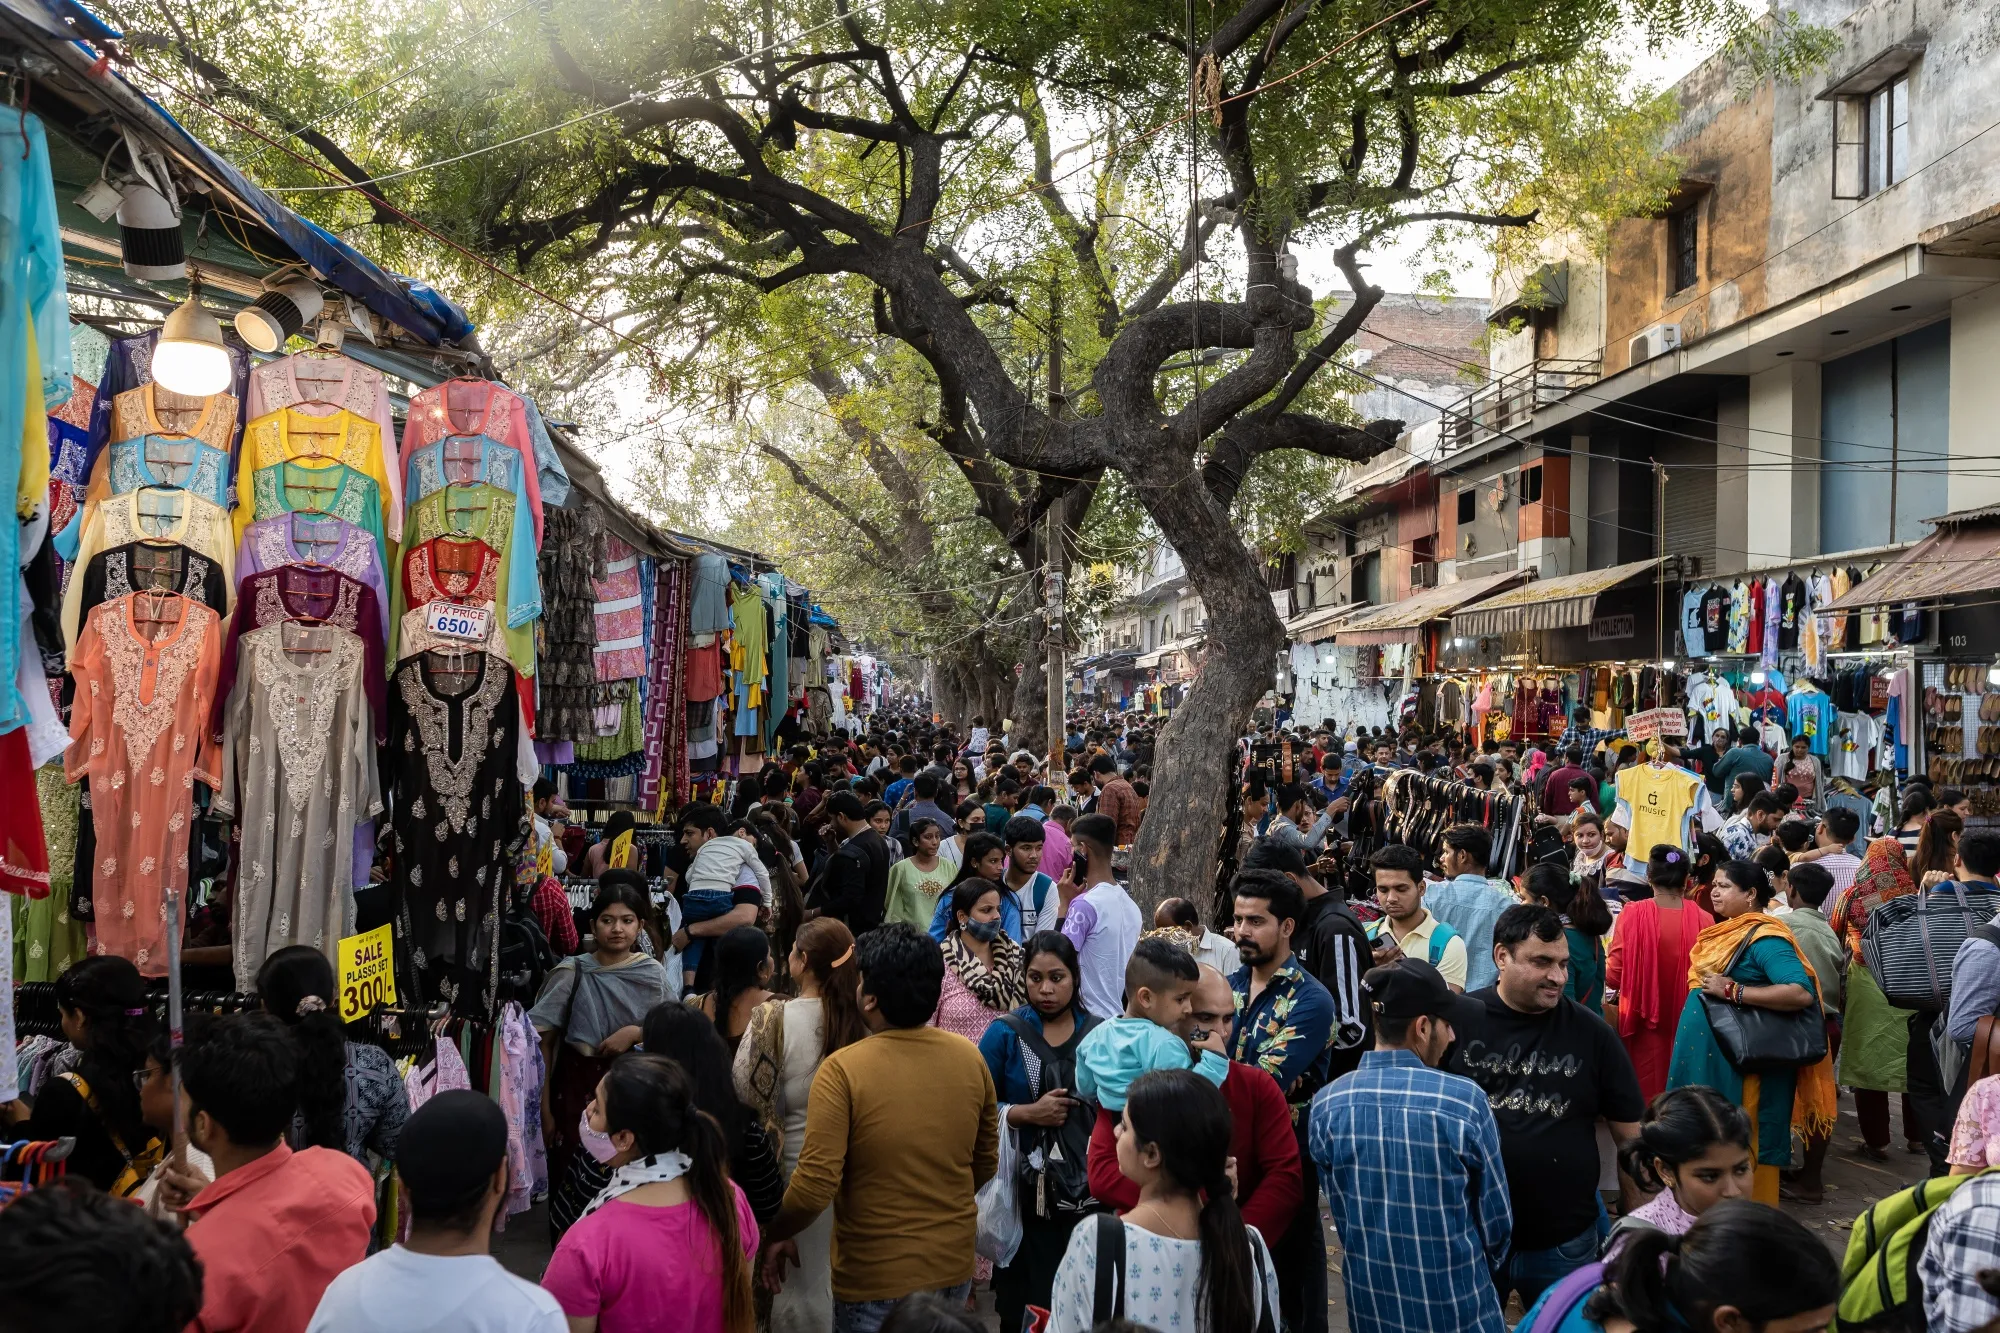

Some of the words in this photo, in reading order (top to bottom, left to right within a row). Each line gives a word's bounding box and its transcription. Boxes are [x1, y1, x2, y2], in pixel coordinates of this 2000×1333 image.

[433, 604, 450, 615] FIX
[452, 607, 485, 621] PRICE
[1600, 616, 1633, 637] COLLECTION
[1949, 635, 1967, 647] 103
[1639, 804, 1667, 817] music
[354, 941, 383, 967] SALE
[346, 963, 377, 985] PLASSO
[378, 957, 389, 973] SET
[1462, 1039, 1583, 1078] Calvin
[1472, 1072, 1571, 1118] lein
